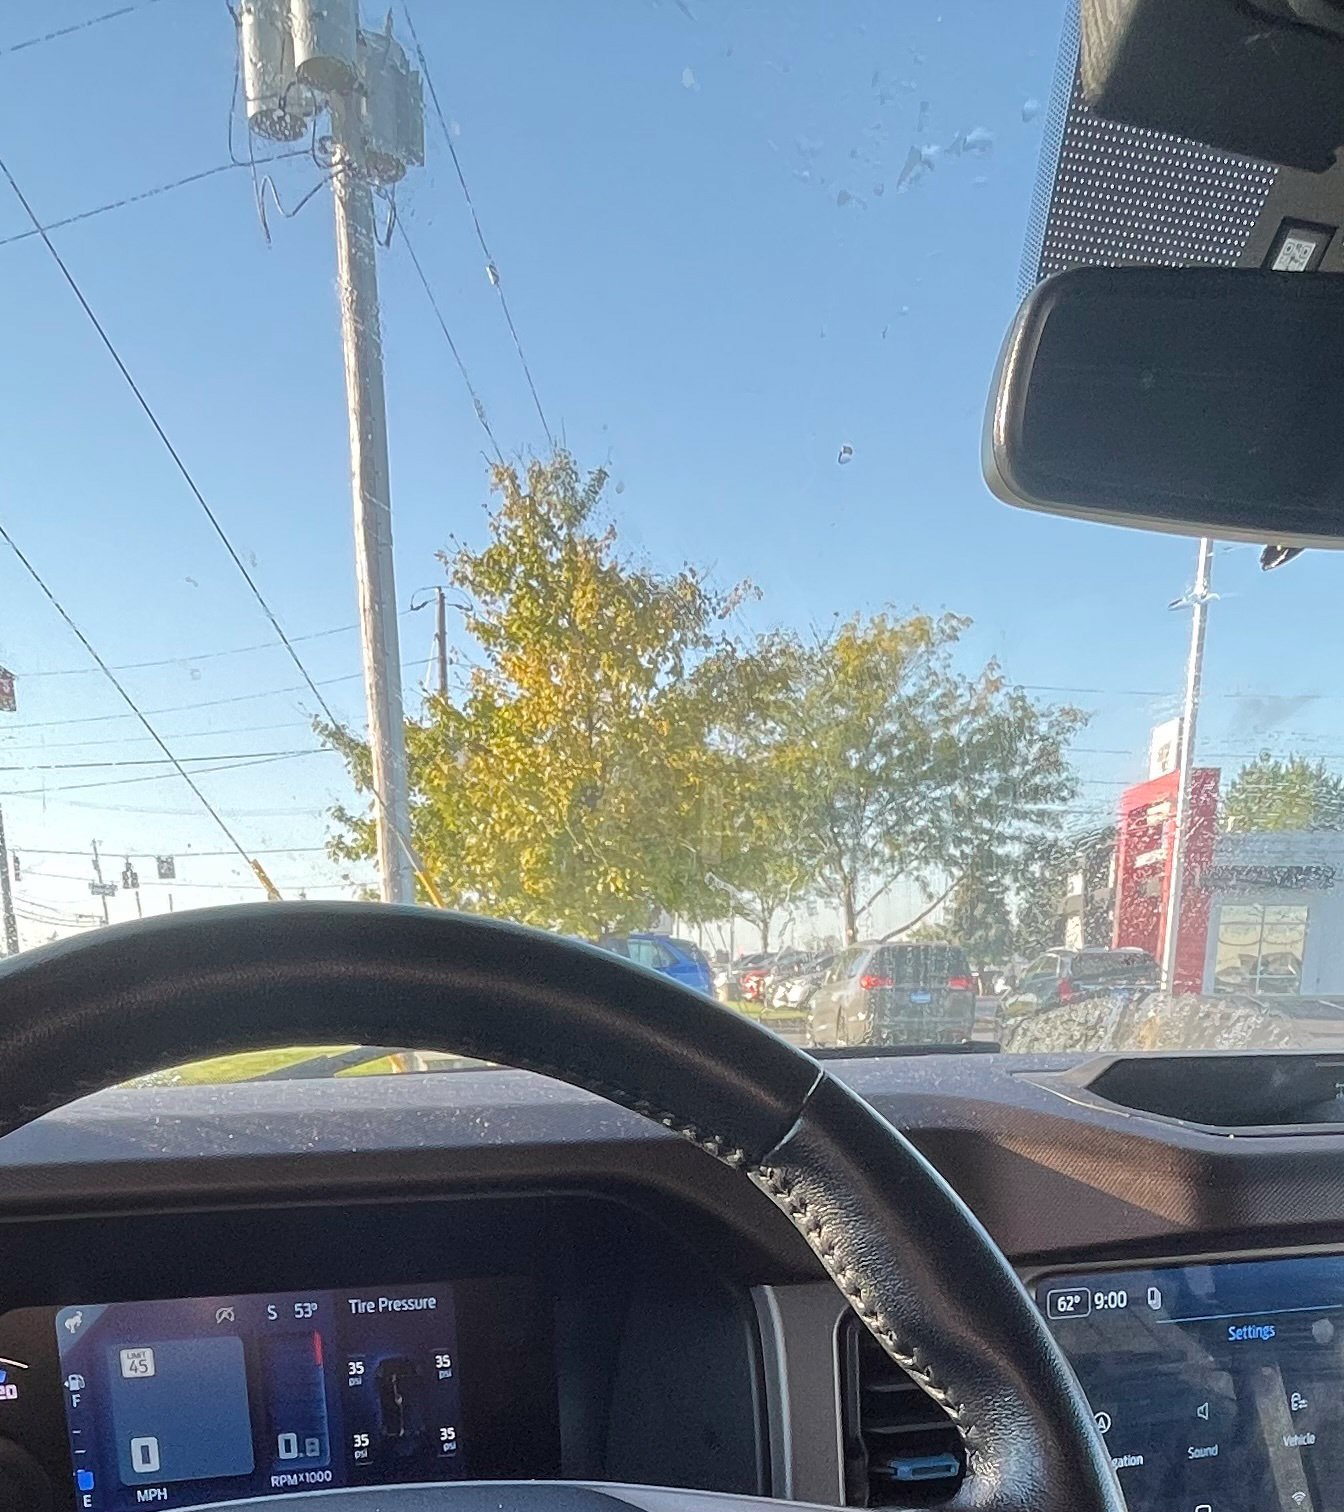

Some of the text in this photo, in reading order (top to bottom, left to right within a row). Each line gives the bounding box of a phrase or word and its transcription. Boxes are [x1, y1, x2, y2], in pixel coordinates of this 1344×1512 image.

[348, 1296, 437, 1314] Tire Pressure
[1057, 1294, 1081, 1312] 62°
[1093, 1290, 1128, 1309] 9:00
[267, 1304, 278, 1321] S
[294, 1302, 317, 1319] 53°
[1228, 1324, 1276, 1342] Settings
[127, 1351, 147, 1360] LIMIT
[435, 1354, 451, 1368] 35
[129, 1359, 149, 1374] 45
[348, 1361, 365, 1375] 35
[71, 1394, 81, 1408] F
[353, 1433, 370, 1447] 35
[439, 1427, 456, 1441] 35
[1283, 1432, 1316, 1447] Vehicle
[131, 1436, 160, 1474] 0
[1188, 1444, 1219, 1460] Sound
[83, 1494, 92, 1508] E
[136, 1487, 168, 1503] MPH
